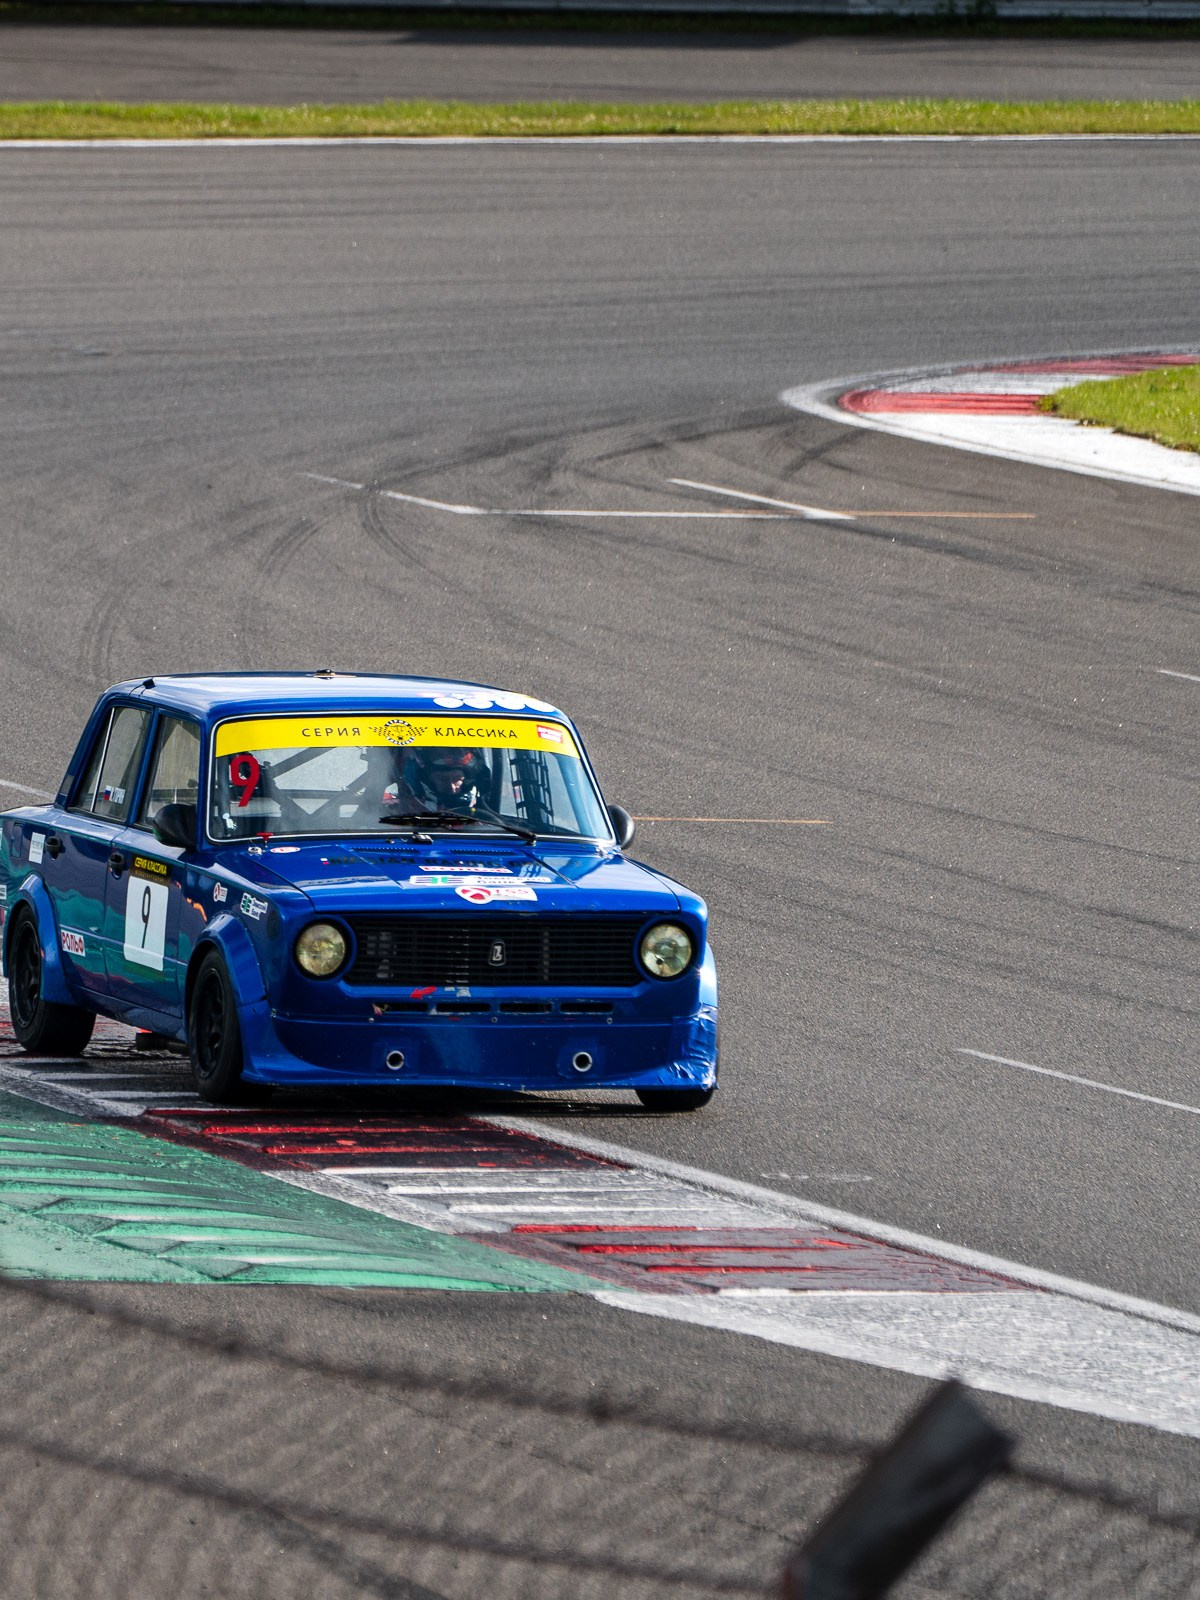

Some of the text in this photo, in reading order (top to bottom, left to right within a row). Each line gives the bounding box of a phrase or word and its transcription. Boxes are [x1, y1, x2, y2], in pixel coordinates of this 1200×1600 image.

[302, 726, 518, 739] СЕРИЯ КЛАССИКА
[230, 754, 260, 807] 9
[142, 886, 151, 948] 9
[61, 931, 84, 954] РОЛЬФ
